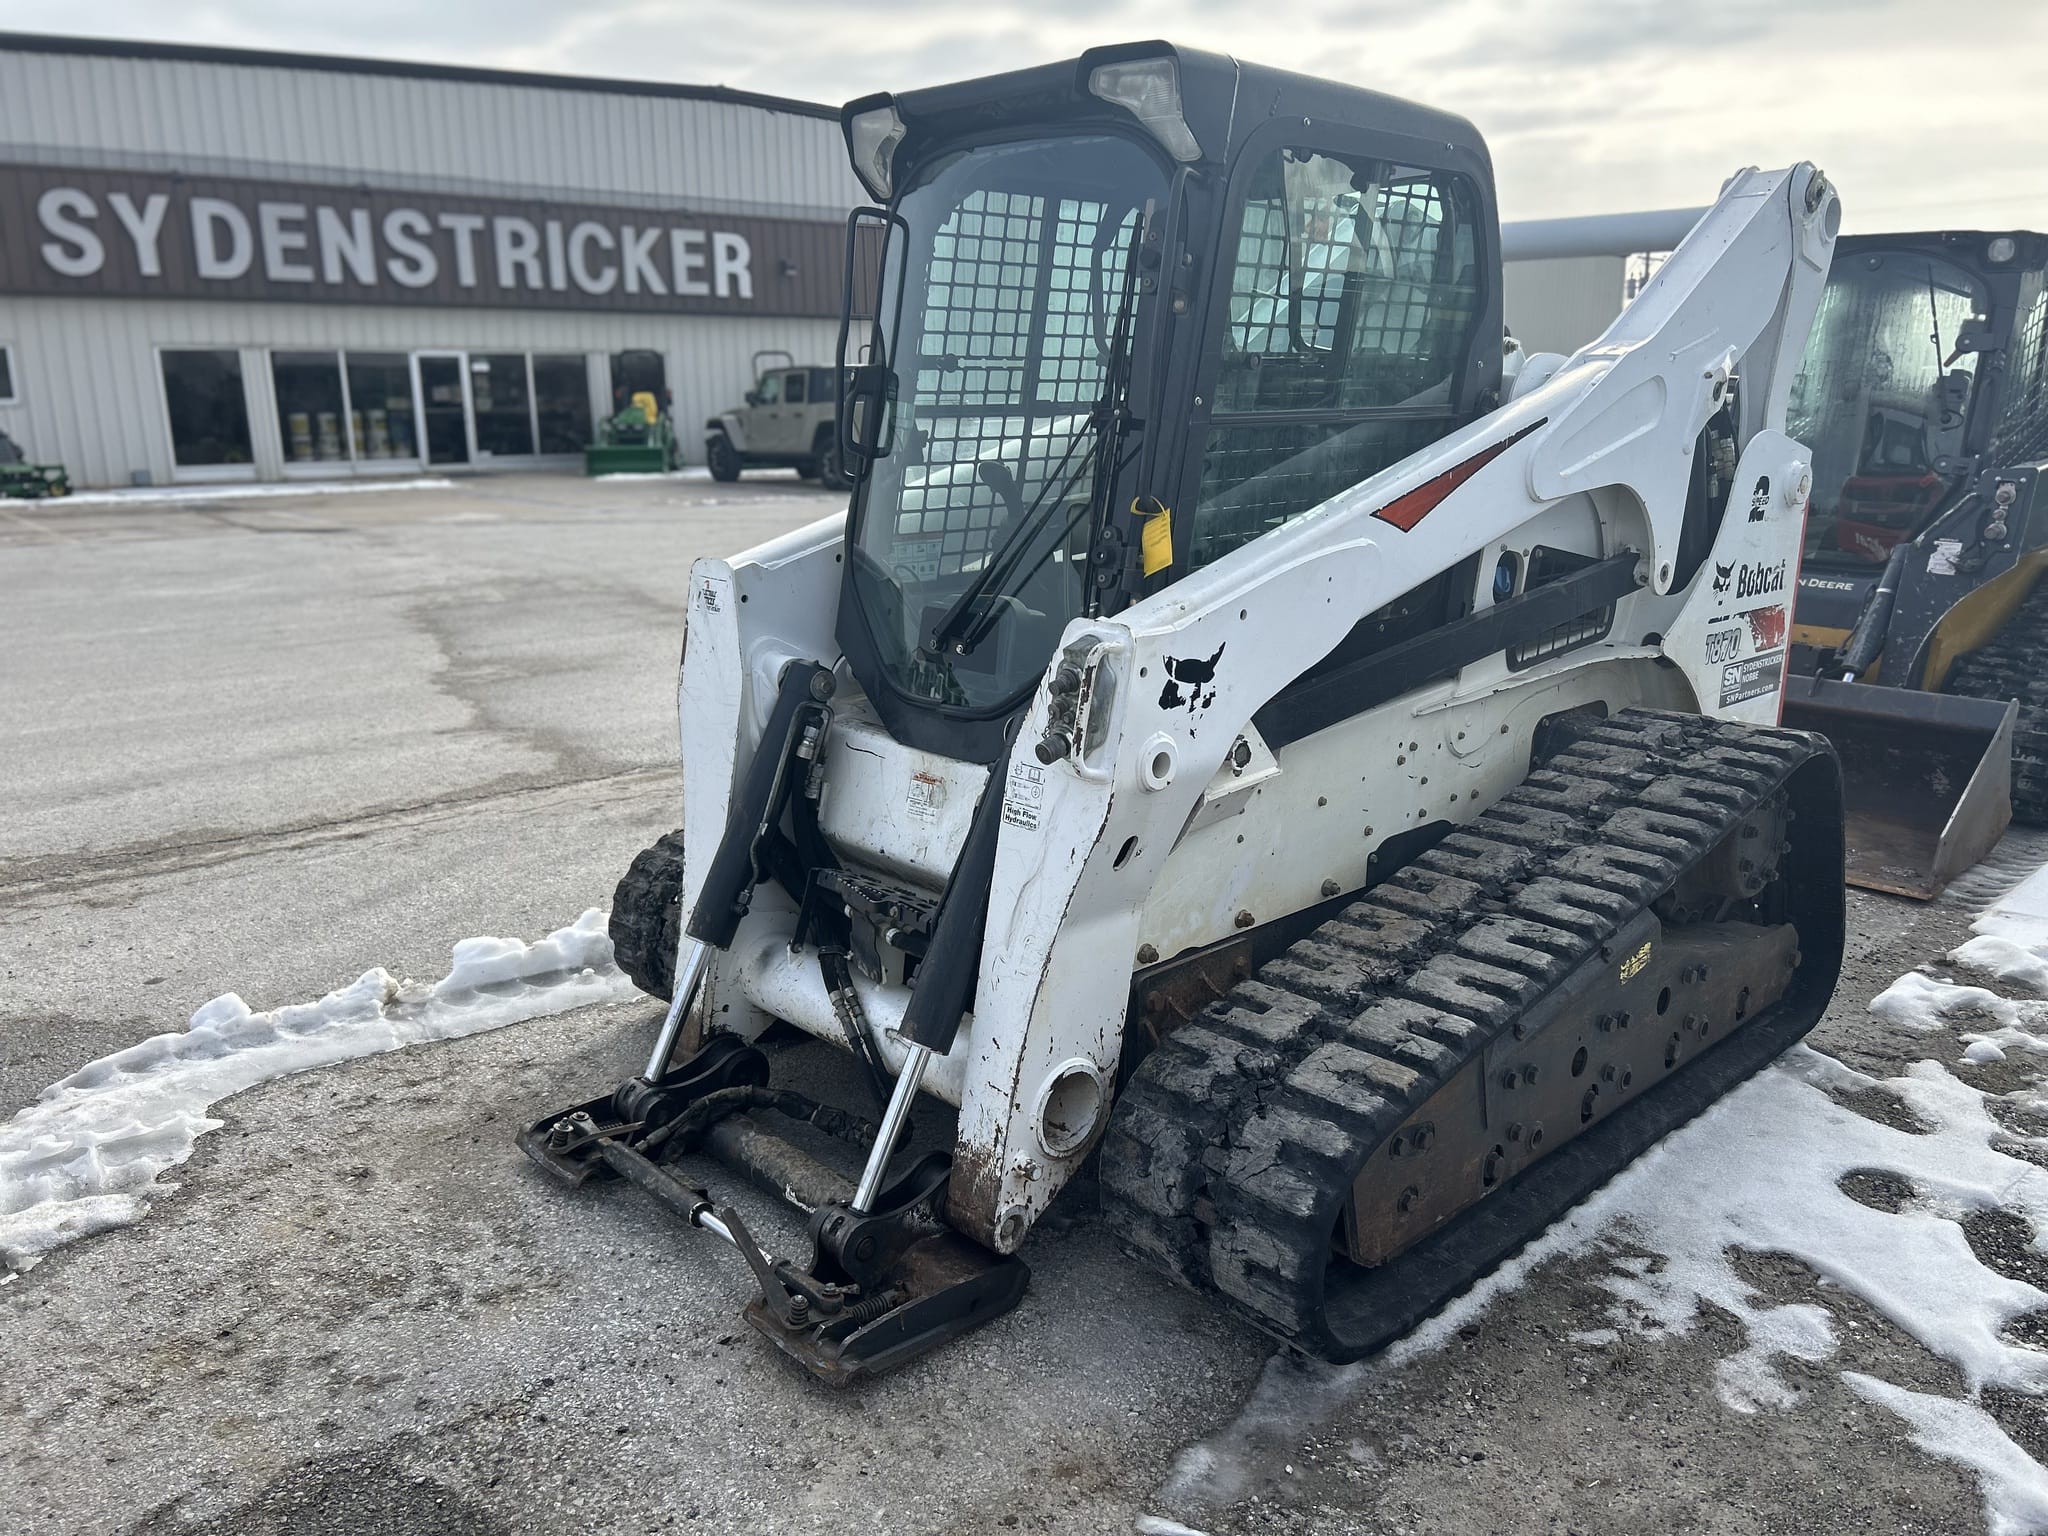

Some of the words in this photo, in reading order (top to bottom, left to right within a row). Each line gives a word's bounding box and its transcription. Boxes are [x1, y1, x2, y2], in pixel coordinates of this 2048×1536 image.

[38, 188, 753, 298] SYDENSTRICKER
[1736, 559, 1786, 599] Bobcat
[1705, 627, 1742, 665] T870
[1724, 666, 1742, 686] SN
[1005, 813, 1037, 829] Hydraulics
[1007, 806, 1021, 816] High
[1022, 811, 1037, 821] Flow
